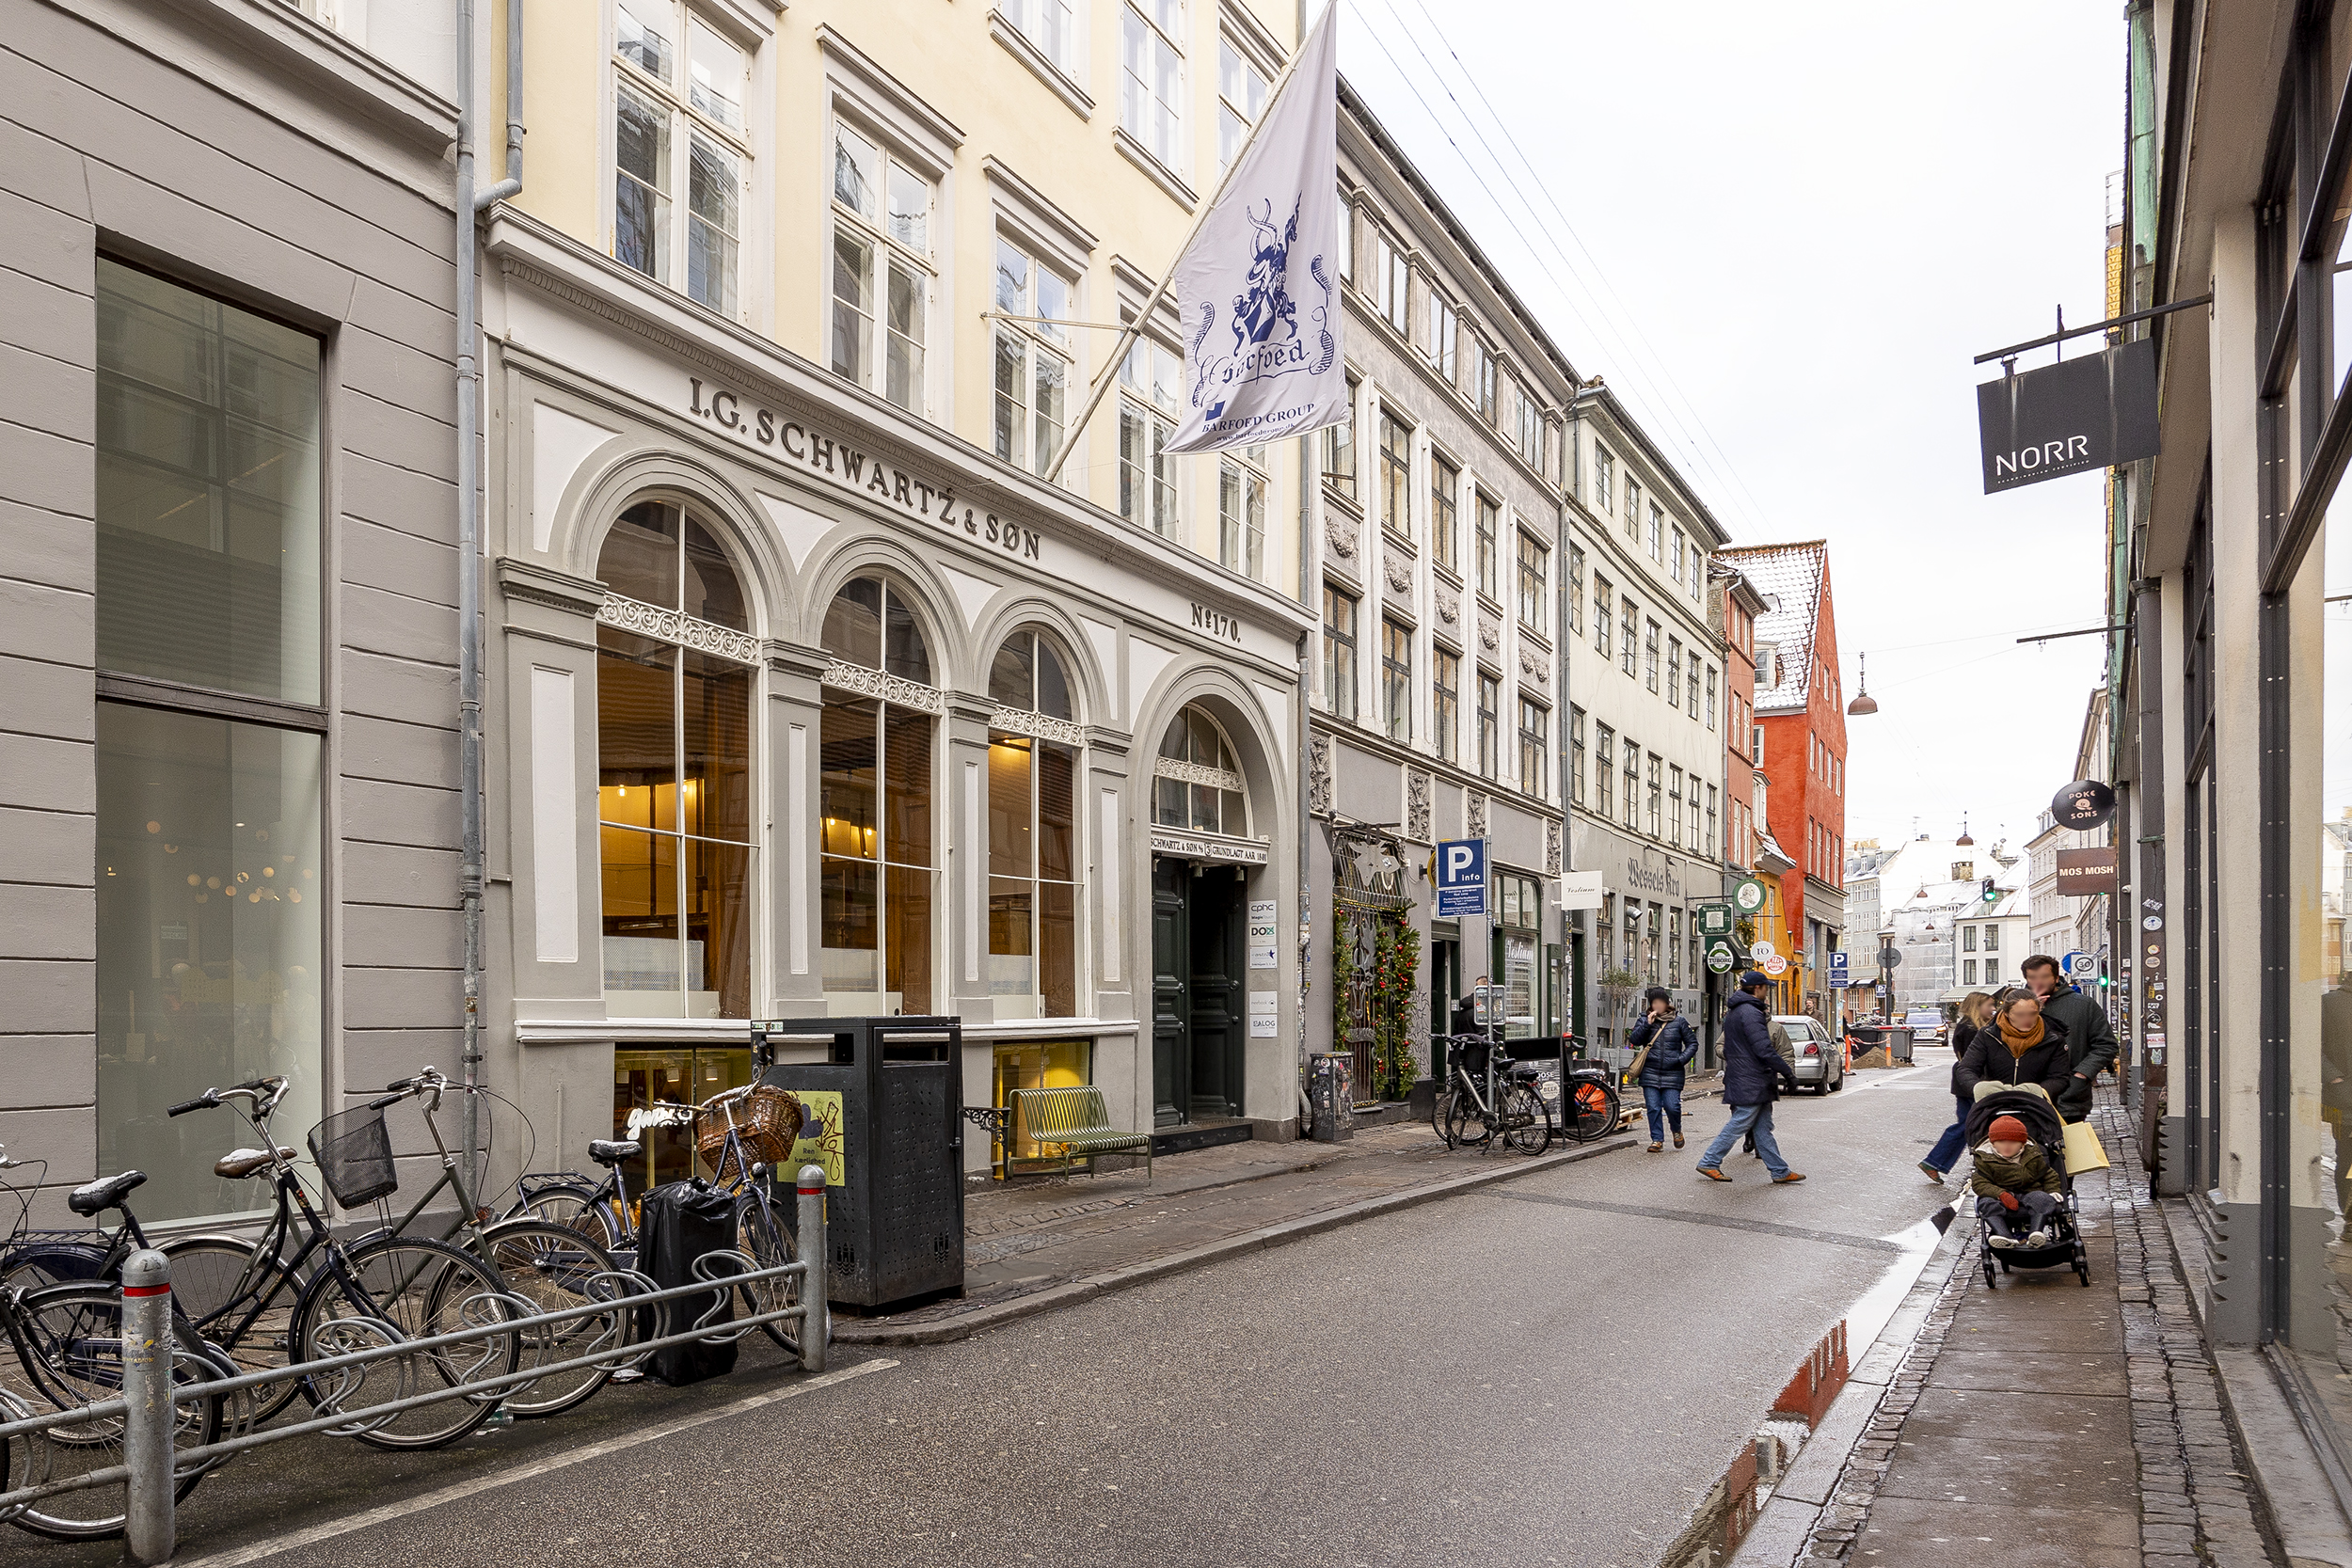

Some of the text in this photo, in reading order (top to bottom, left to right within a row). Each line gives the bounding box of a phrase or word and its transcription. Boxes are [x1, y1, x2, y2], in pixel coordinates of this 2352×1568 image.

[1265, 403, 1315, 424] GROUP
[1995, 435, 2089, 476] NORR
[756, 408, 958, 527] SCHWARTZ
[963, 508, 977, 536] &
[985, 514, 1041, 562] SØN
[2068, 789, 2096, 800] POKE
[2070, 810, 2098, 820] SONS
[1448, 847, 1473, 882] P
[1461, 873, 1481, 881] info
[2059, 865, 2114, 877] MOS MOSH
[1250, 903, 1274, 912] cphc
[1834, 954, 1845, 967] P
[794, 1156, 826, 1165] kærlighed
